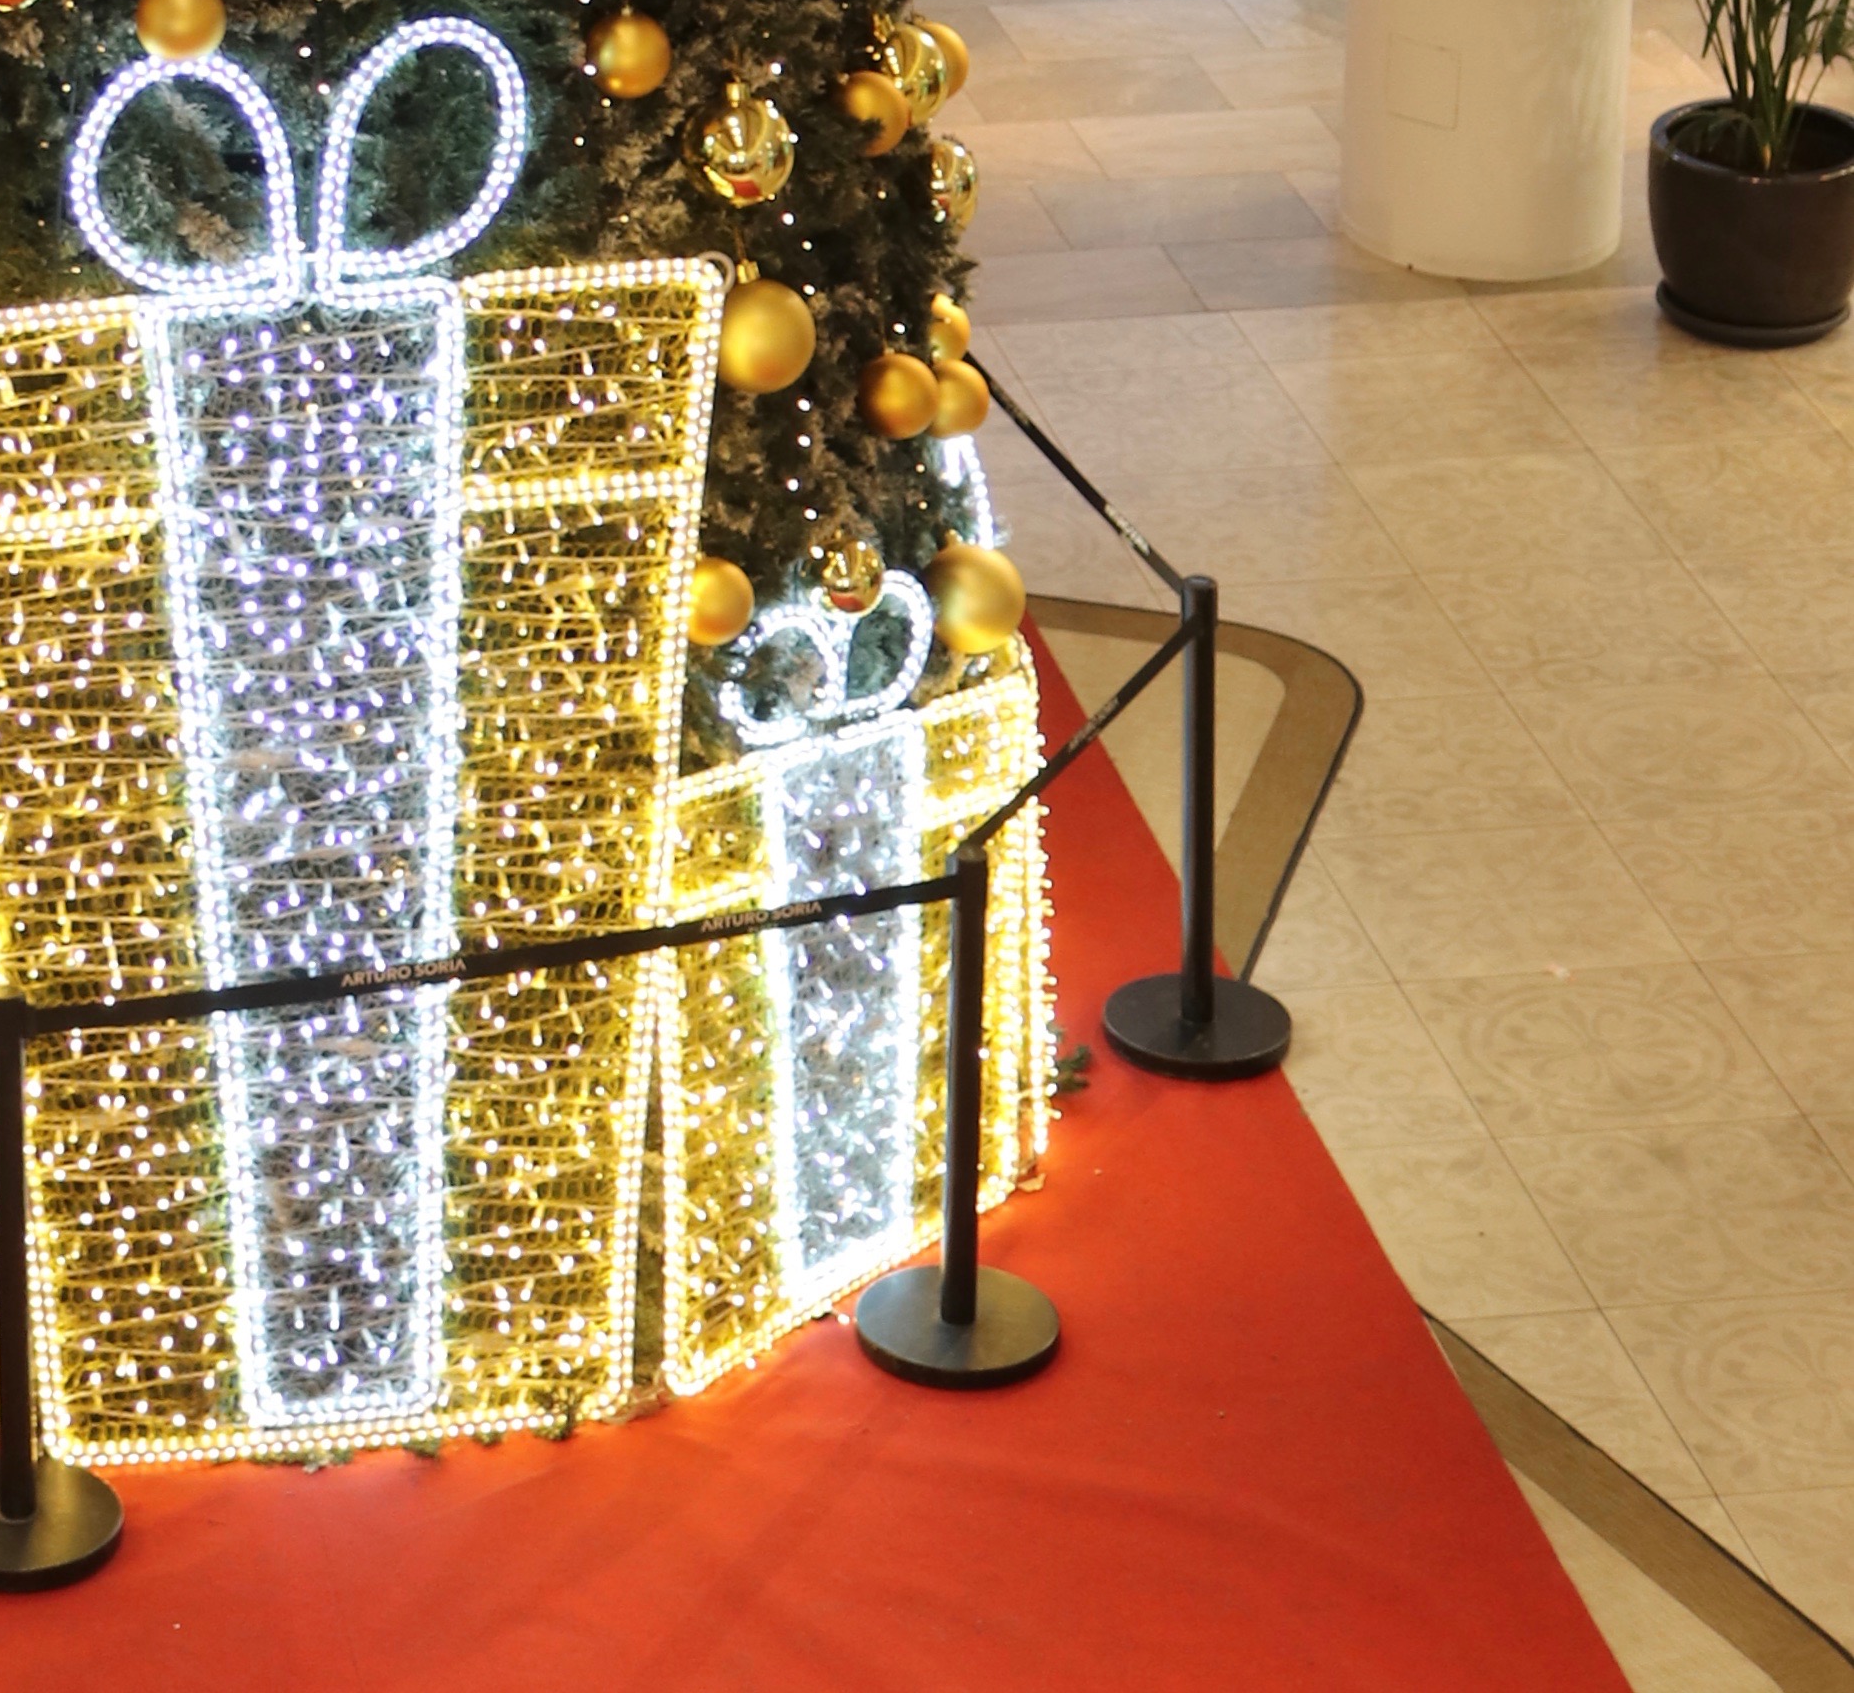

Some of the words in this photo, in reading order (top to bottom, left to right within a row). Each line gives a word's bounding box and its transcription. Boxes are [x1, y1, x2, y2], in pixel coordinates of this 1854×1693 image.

[700, 910, 769, 933] ARTURO
[770, 900, 823, 922] SORIA
[340, 964, 413, 988] ARTURO
[413, 957, 467, 978] SORIA
